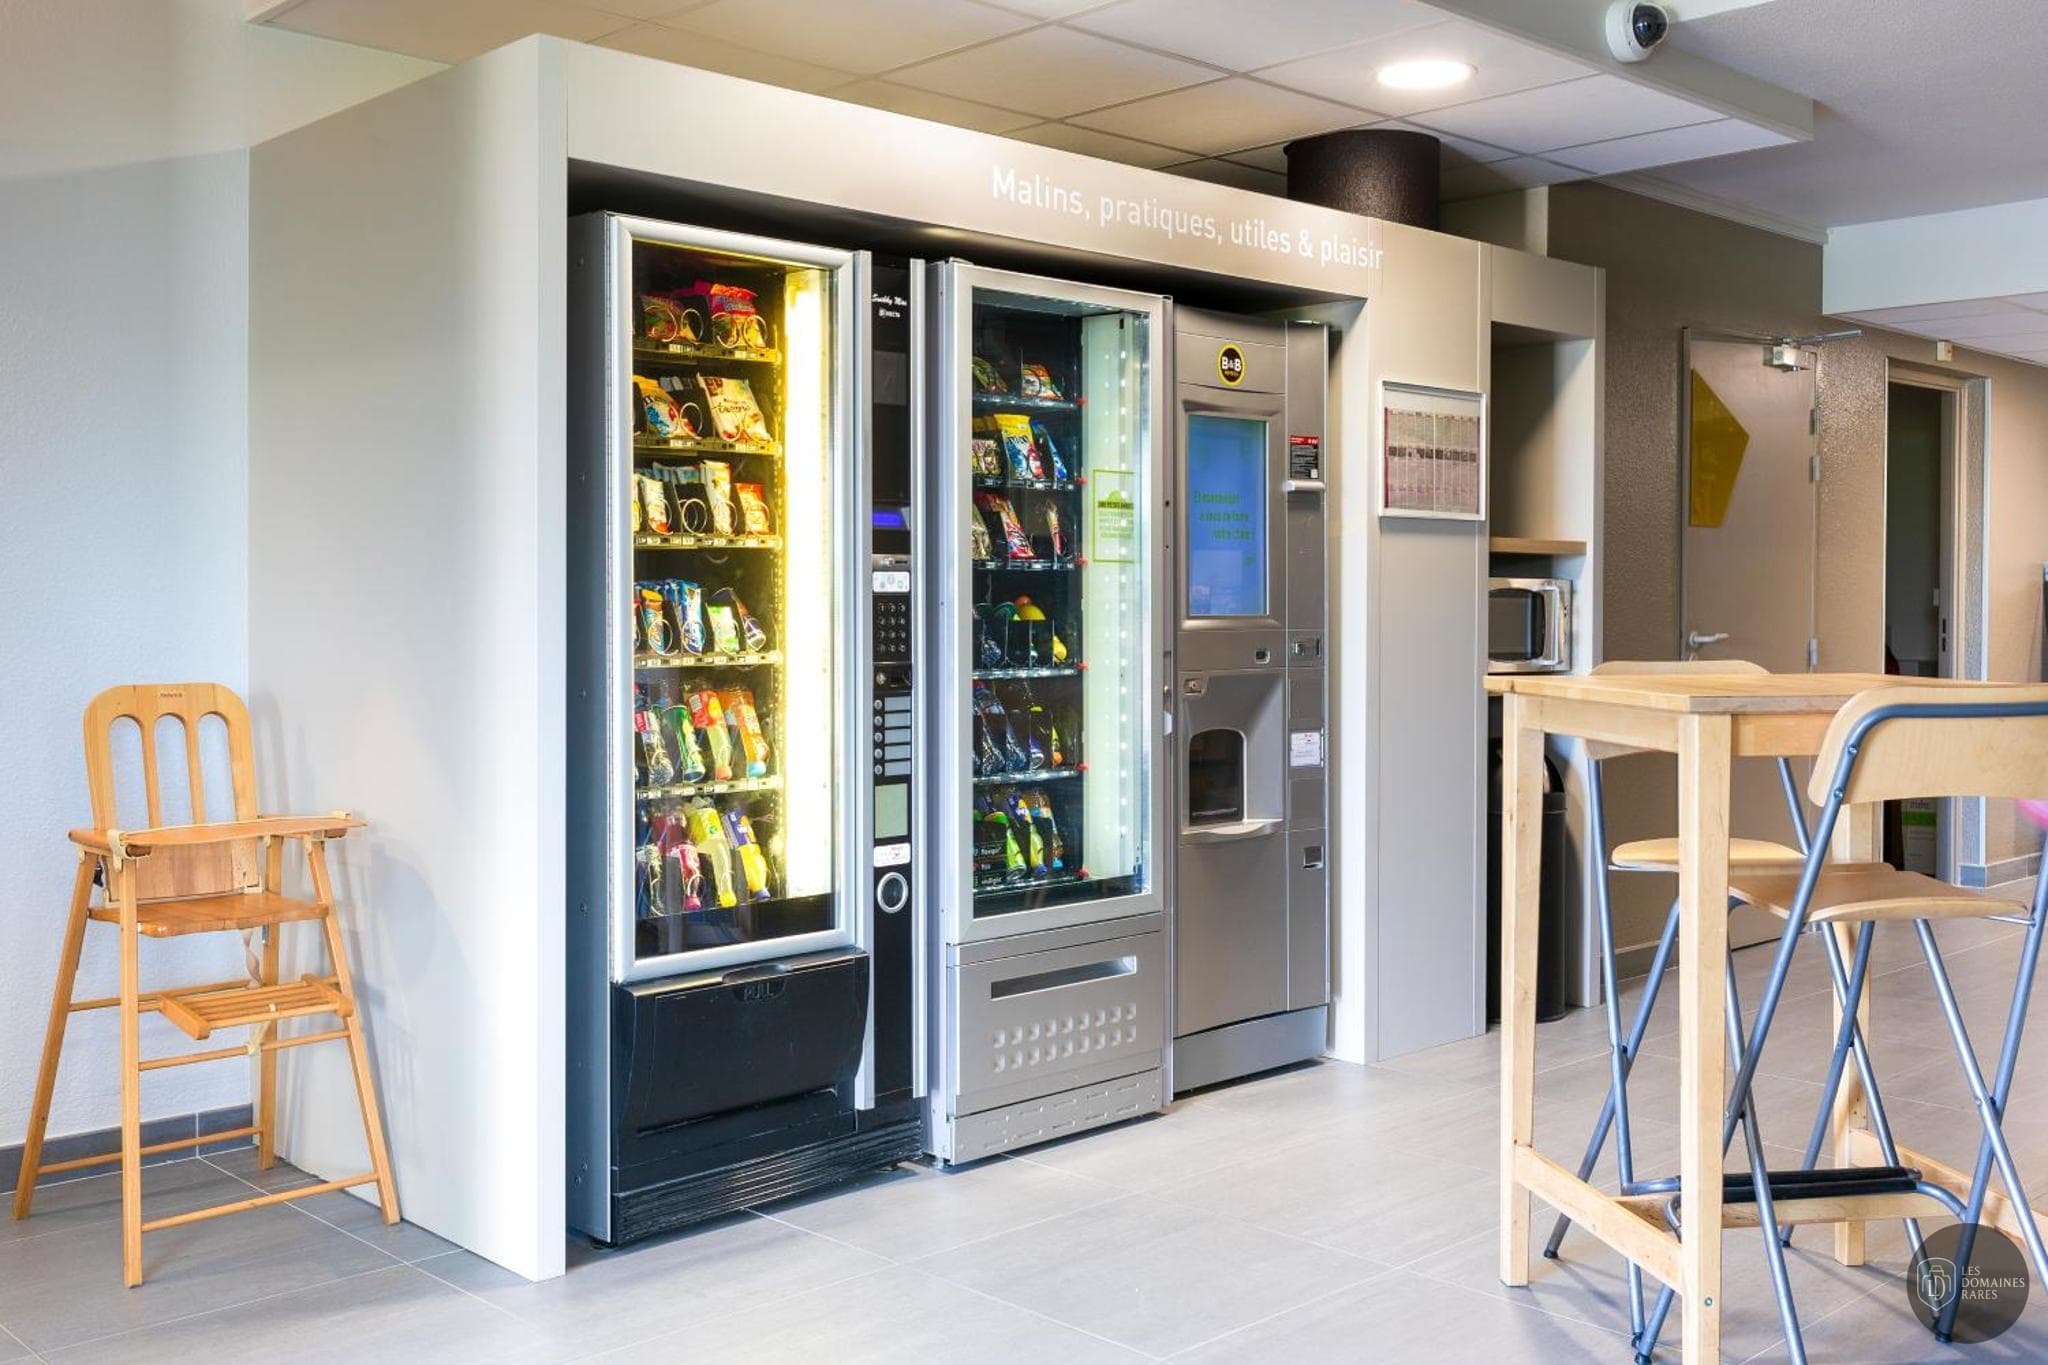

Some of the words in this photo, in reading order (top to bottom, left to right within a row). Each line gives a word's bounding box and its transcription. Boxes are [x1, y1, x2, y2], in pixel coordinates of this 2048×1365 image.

[992, 166, 1091, 220] Malins,
[1100, 196, 1223, 245] pratiques,
[1230, 222, 1291, 253] utiles
[1299, 230, 1315, 258] &
[1320, 235, 1384, 269] plaisir
[1221, 356, 1242, 372] B&B
